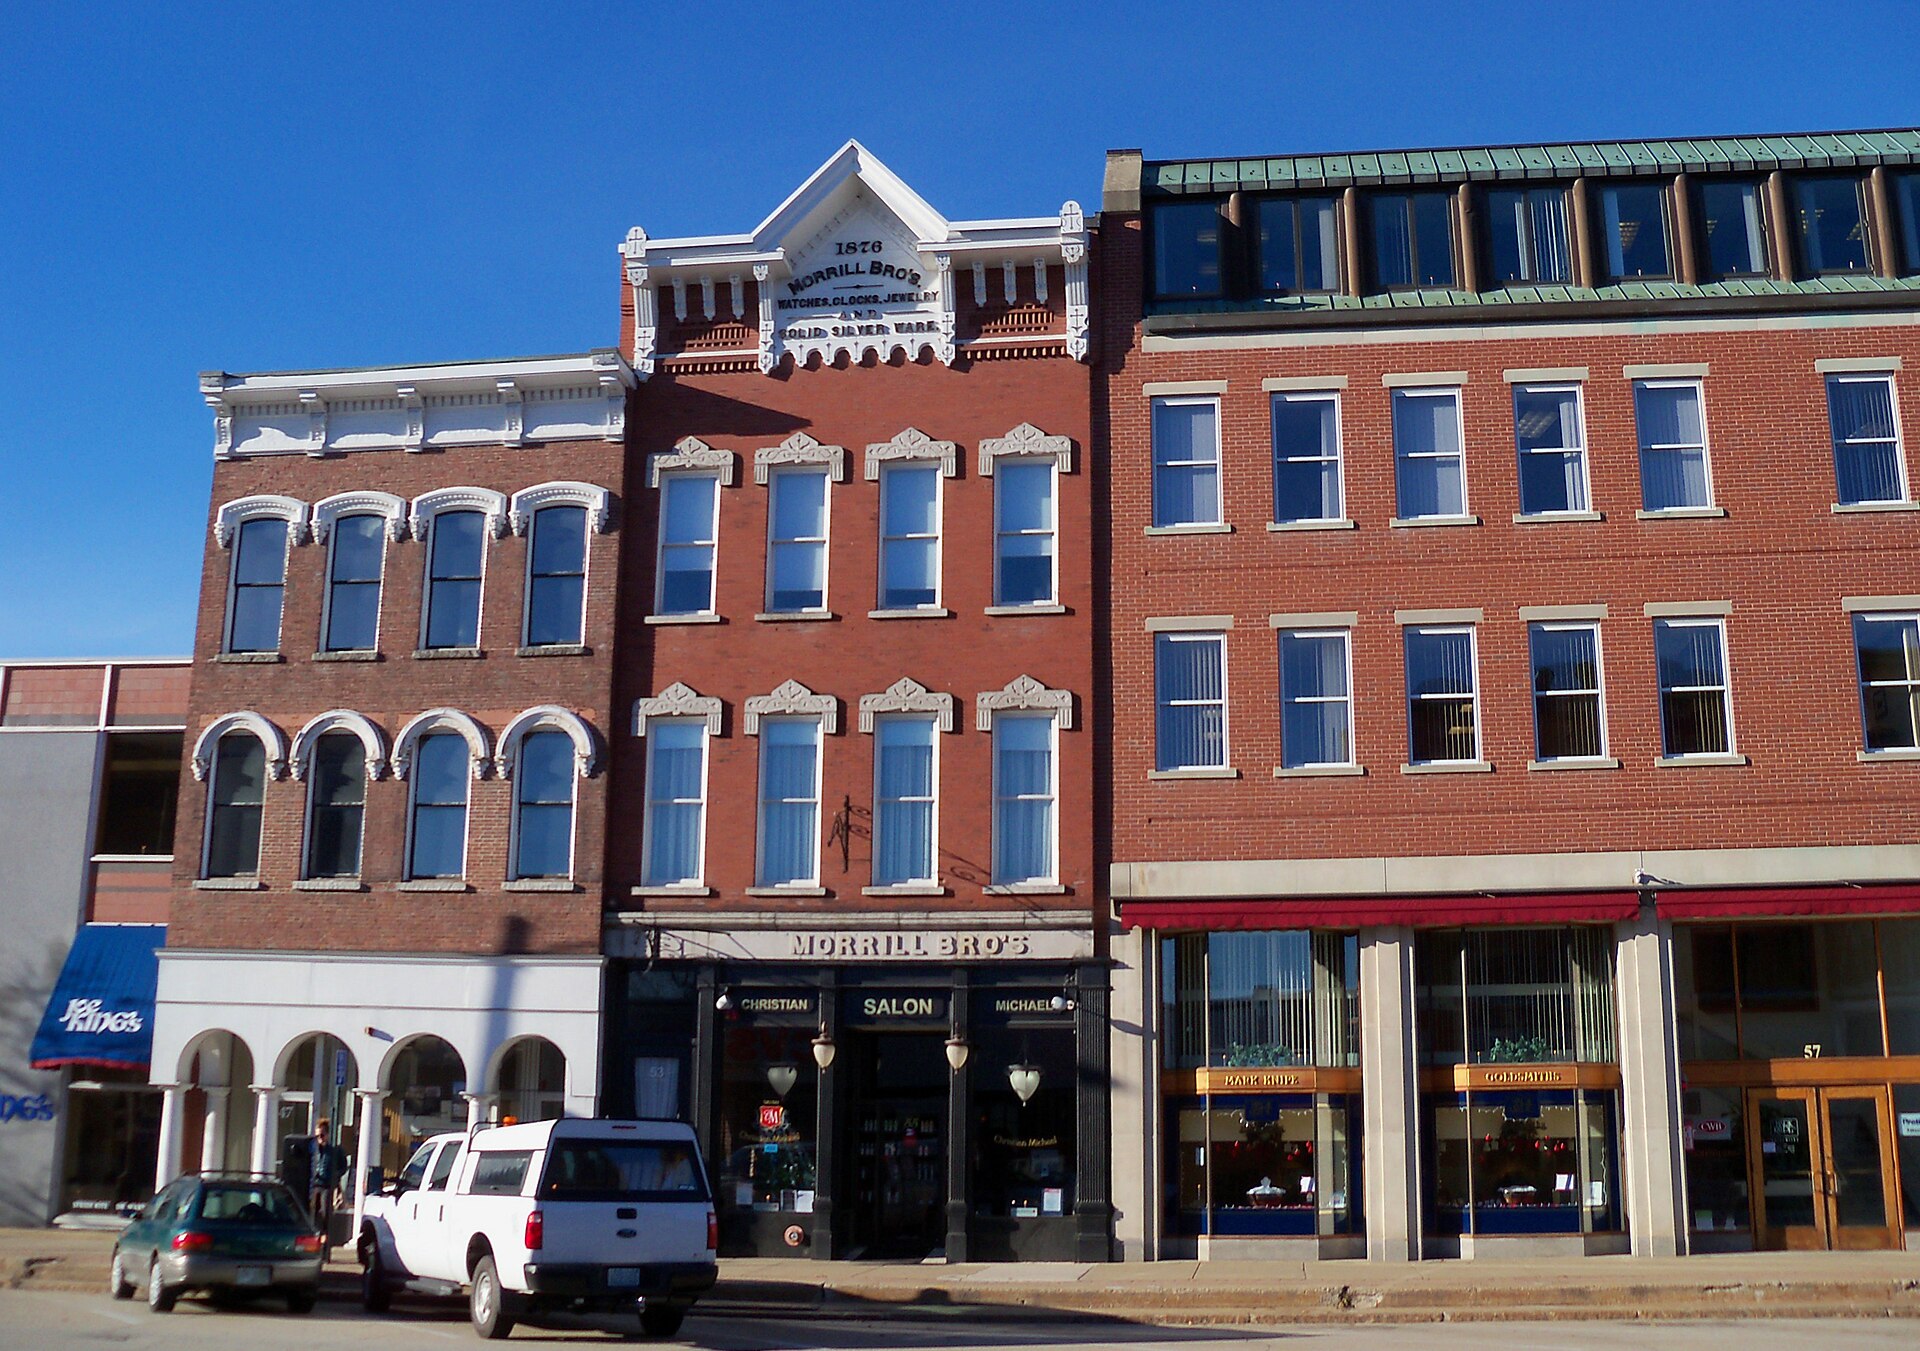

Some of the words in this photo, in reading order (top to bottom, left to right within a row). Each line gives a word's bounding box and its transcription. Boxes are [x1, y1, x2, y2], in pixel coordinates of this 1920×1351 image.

[835, 241, 883, 255] 1876
[787, 262, 866, 295] MORRILL
[778, 327, 824, 339] SOLID
[831, 324, 887, 336] SILVER
[791, 935, 928, 956] MORRILL
[741, 998, 808, 1011] CHRISTIAN
[863, 998, 933, 1015] SALON
[995, 1000, 1054, 1011] MICHAEL
[1803, 1045, 1822, 1059] 57
[1224, 1075, 1258, 1086] MARK
